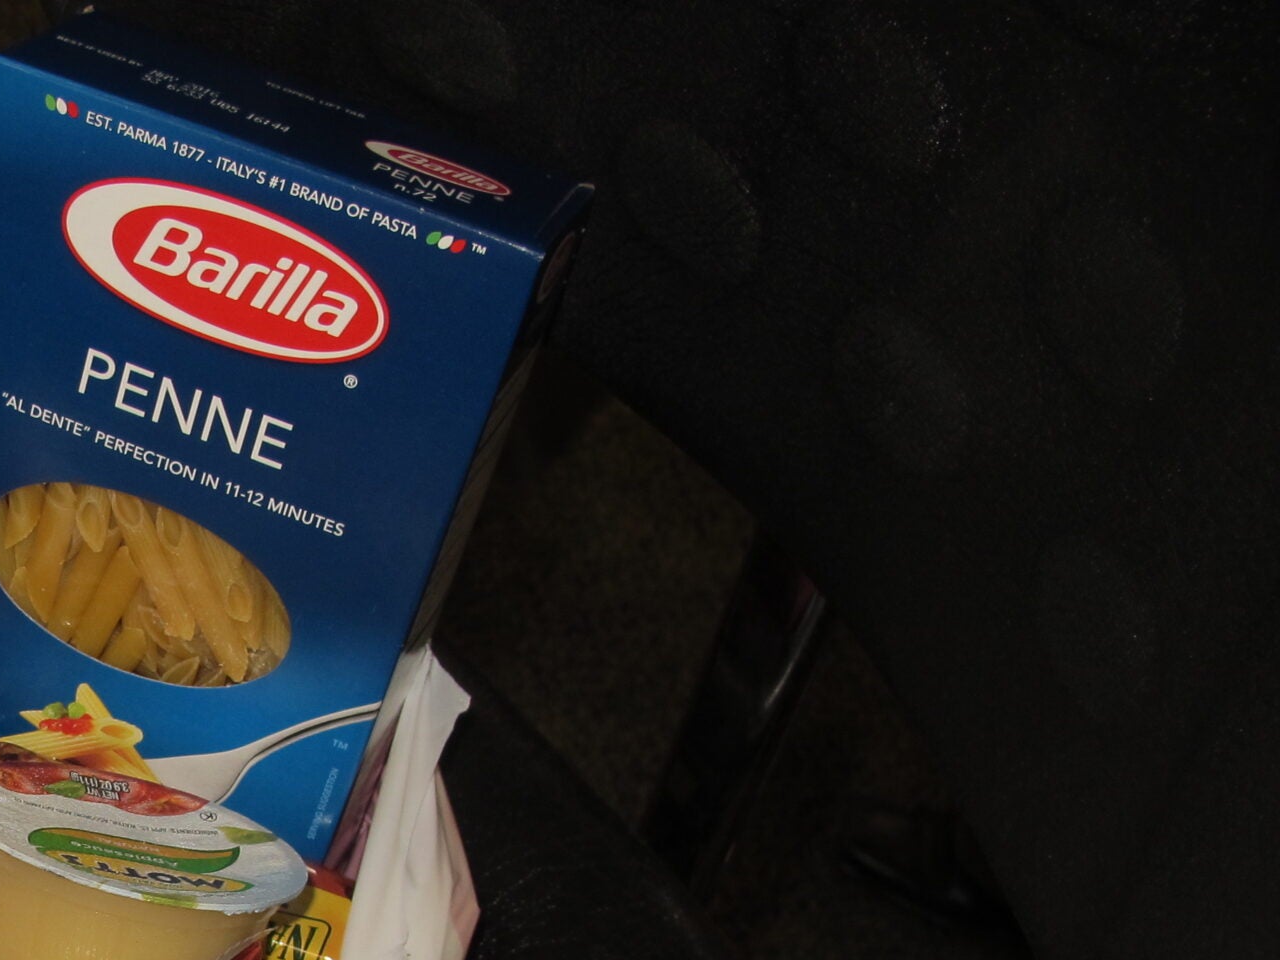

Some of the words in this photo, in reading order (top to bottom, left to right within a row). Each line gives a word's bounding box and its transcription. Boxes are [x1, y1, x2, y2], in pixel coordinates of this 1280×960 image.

[85, 110, 113, 131] EST.
[116, 122, 167, 151] PARMA
[172, 141, 206, 162] 1877
[215, 155, 267, 185] ITALY'S
[269, 175, 287, 192] #1
[289, 181, 344, 213] BRAND
[346, 202, 370, 220] OF
[371, 211, 417, 240] PASTA
[372, 162, 475, 204] PENNE
[397, 152, 499, 192] Barilla
[132, 217, 359, 338] Barilla
[77, 347, 295, 470] PENNE
[94, 430, 197, 482] PERFECTION
[200, 471, 221, 491] IN
[224, 480, 265, 507] 11-12
[267, 496, 346, 538] MINUTES
[103, 789, 120, 801] NET
